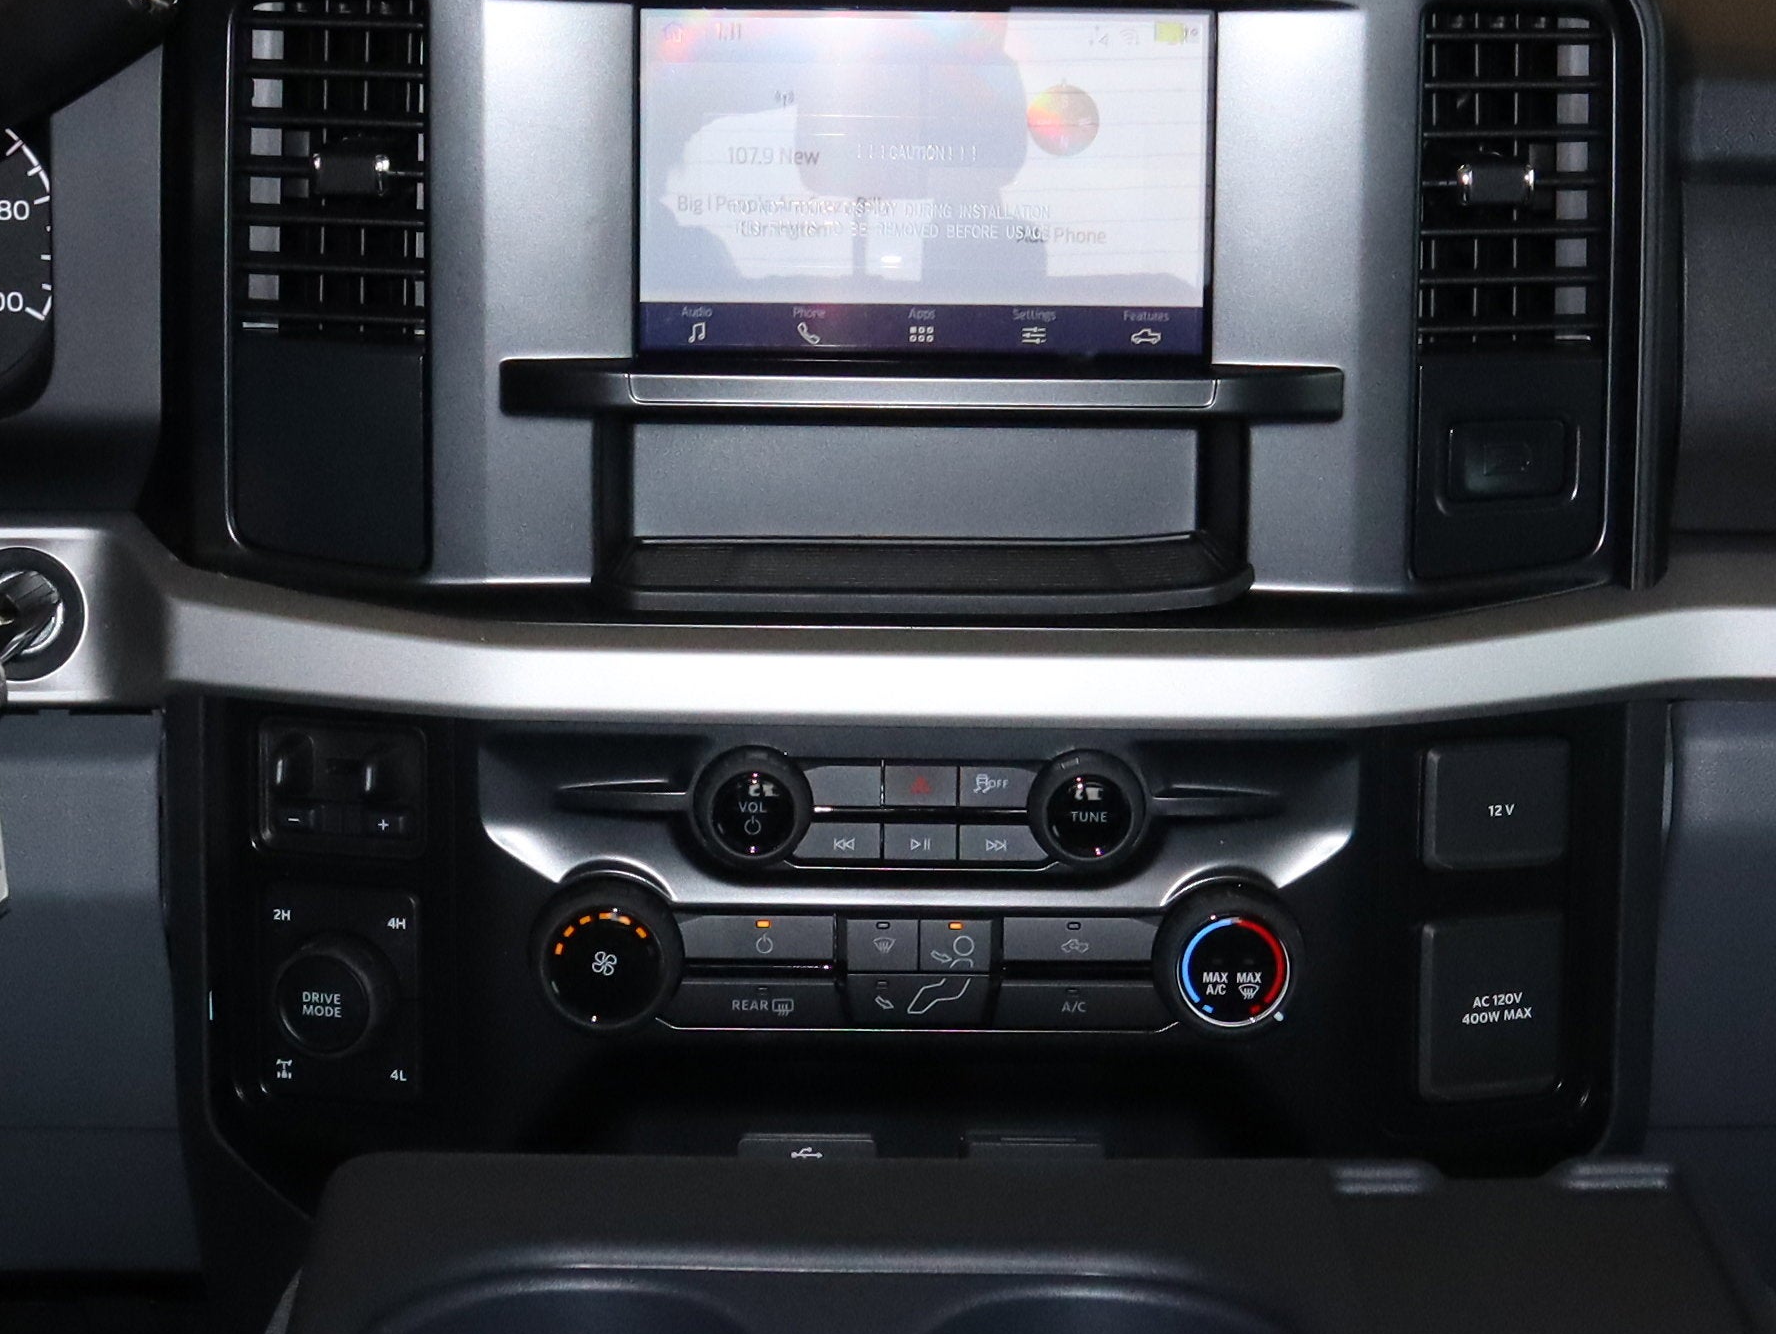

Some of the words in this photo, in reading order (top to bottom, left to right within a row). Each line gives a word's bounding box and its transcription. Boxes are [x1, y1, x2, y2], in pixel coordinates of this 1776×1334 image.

[727, 146, 774, 166] 107.9
[779, 146, 821, 165] New
[677, 195, 703, 215] Big
[947, 223, 999, 239] BEFORE
[1053, 227, 1107, 244] Phone
[681, 306, 713, 318] Audio
[792, 306, 826, 319] Phone
[907, 307, 936, 320] Apps
[1012, 308, 1057, 321] Settings
[1122, 309, 1170, 322] Features
[738, 801, 767, 814] VOL
[1487, 804, 1503, 818] 12
[1070, 811, 1108, 823] TUNE
[272, 908, 292, 922] 2H
[386, 917, 407, 931] 4H
[1201, 971, 1229, 984] MAX
[1236, 971, 1262, 984] MAX
[1205, 983, 1227, 996] A/C
[301, 990, 342, 1005] DRIVE
[1472, 995, 1490, 1010] AC
[1492, 991, 1524, 1007] 120V
[301, 1004, 343, 1018] MODE
[731, 998, 769, 1011] REAR
[1061, 1000, 1087, 1014] A/C
[1461, 1010, 1501, 1026] 400W
[1503, 1006, 1533, 1022] MAX
[389, 1069, 408, 1082] 4L
